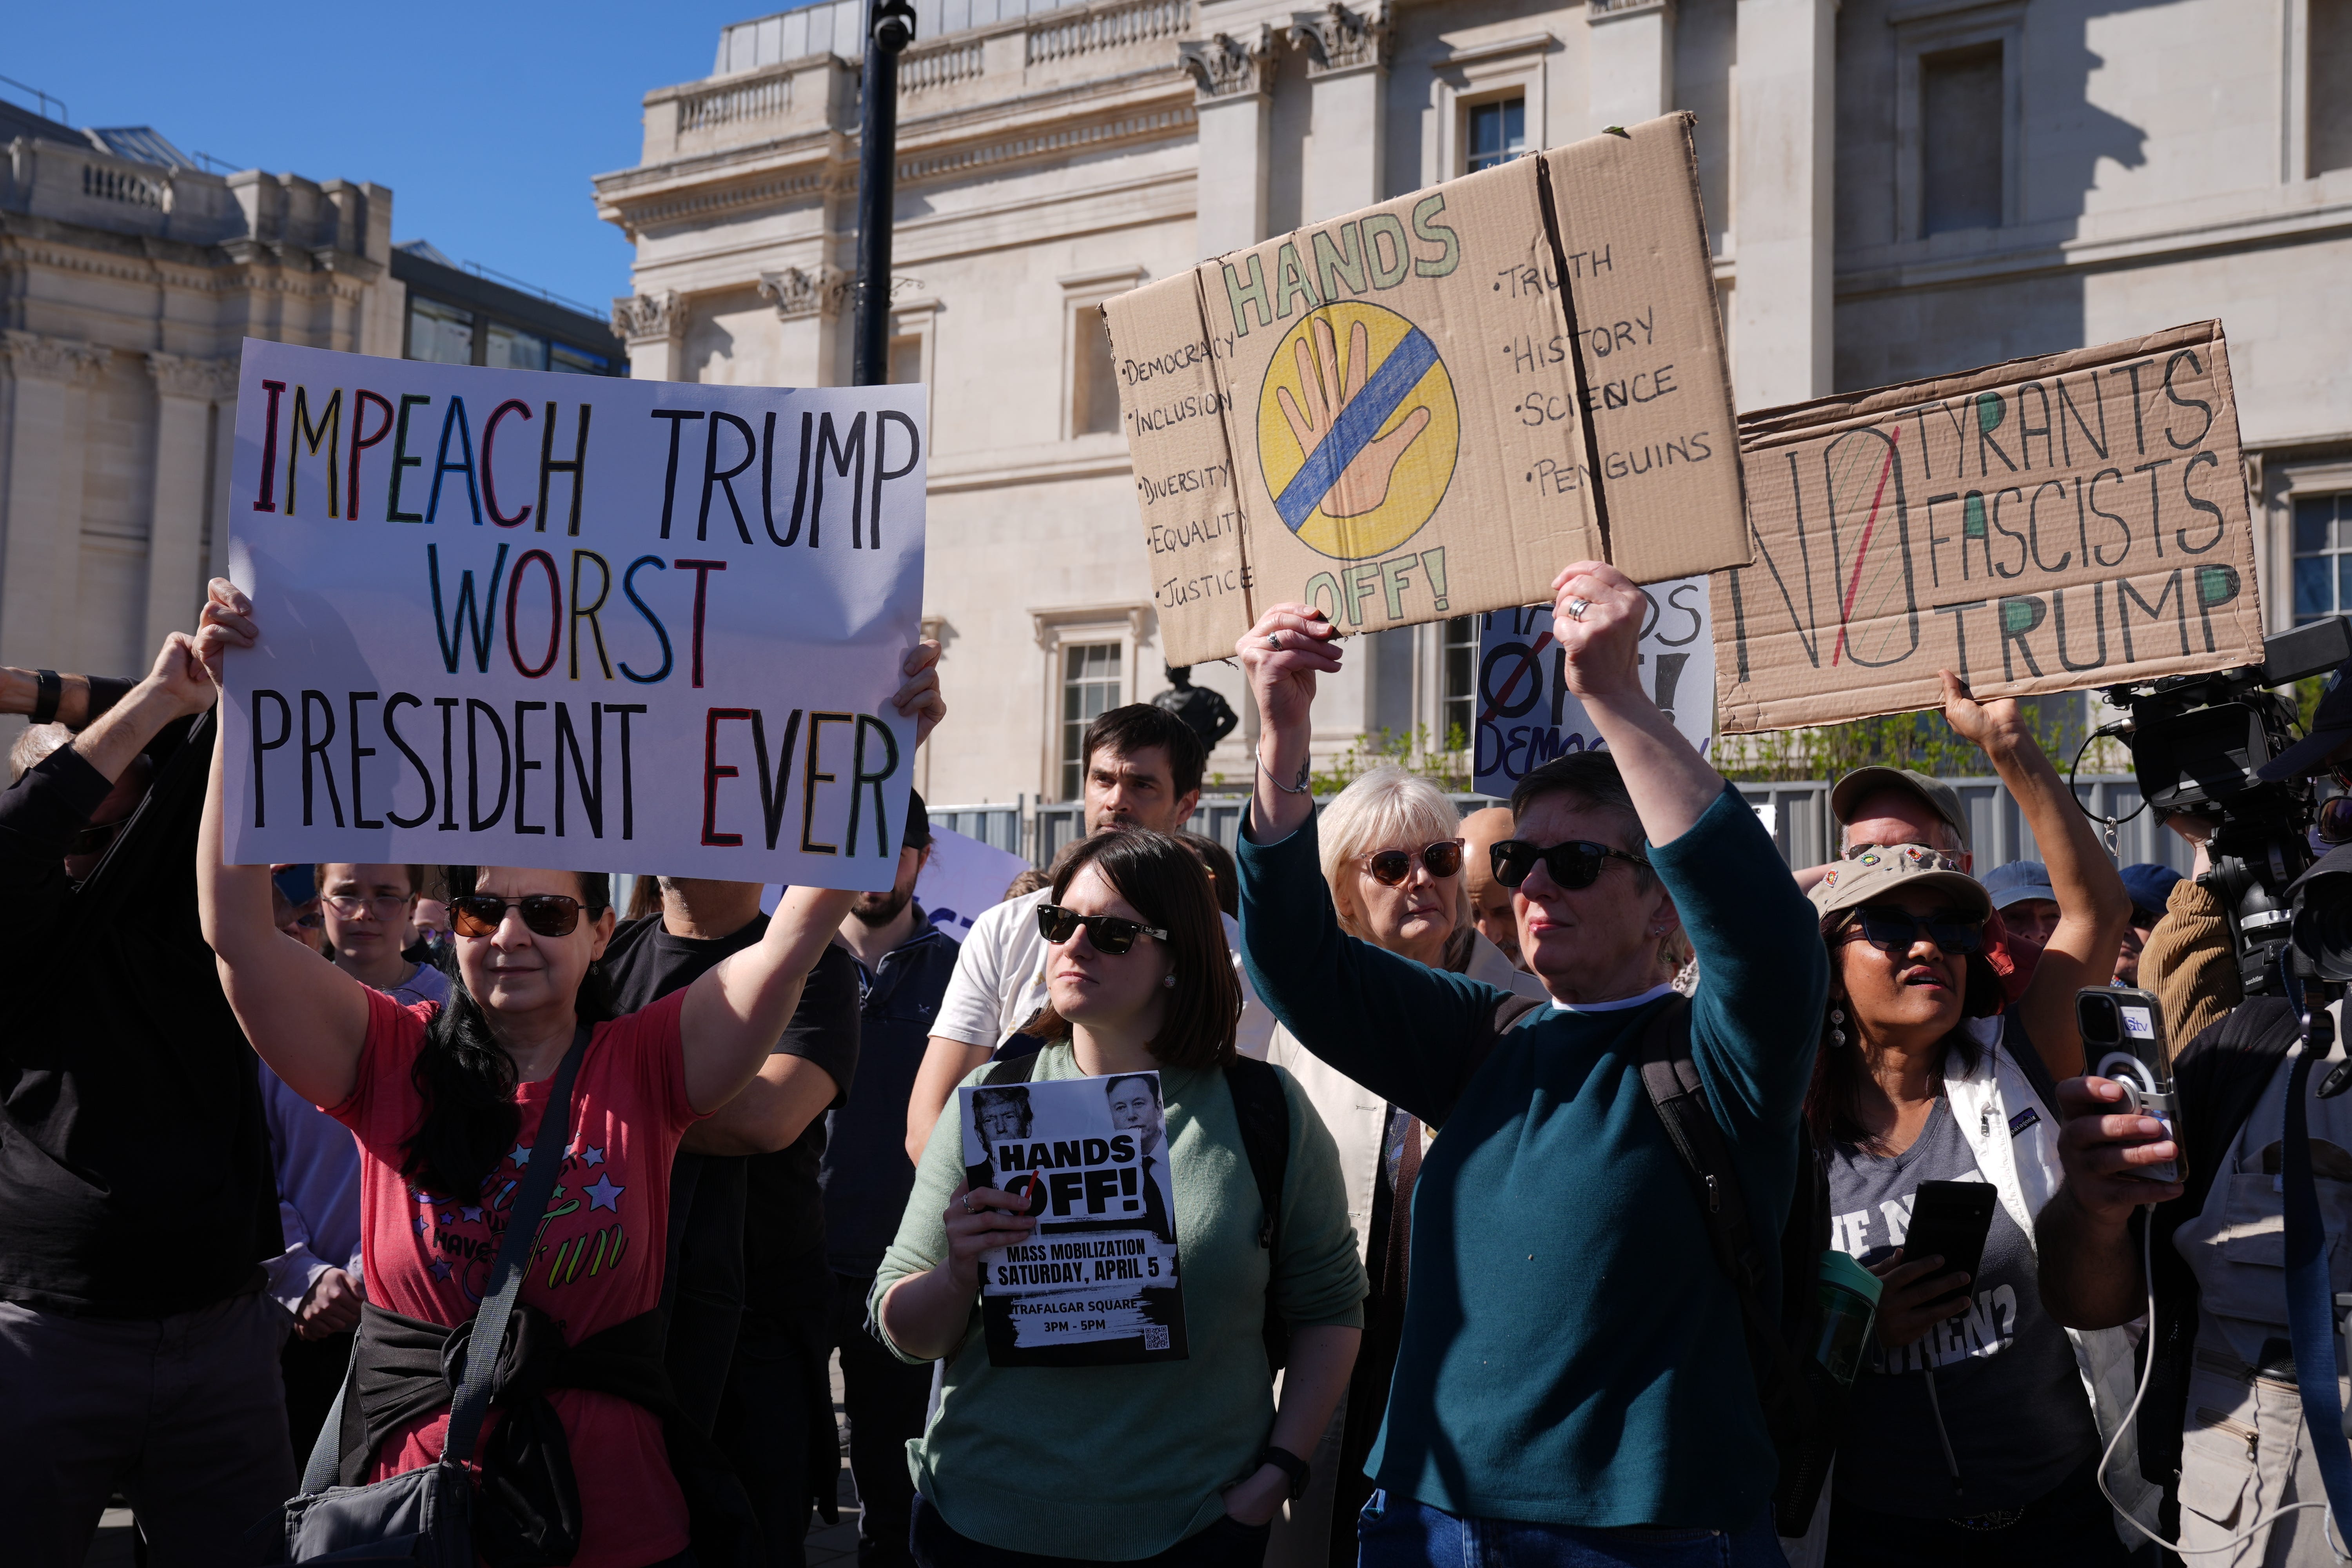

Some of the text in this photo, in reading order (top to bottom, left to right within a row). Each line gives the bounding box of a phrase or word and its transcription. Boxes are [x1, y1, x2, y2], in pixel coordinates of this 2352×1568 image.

[1222, 192, 1460, 338] HANDS
[1498, 244, 1612, 299] TRUTH
[1125, 331, 1233, 386] DEMOCRACY
[1514, 306, 1652, 374] HISTORY
[1136, 389, 1232, 437] INCLUSION
[1522, 365, 1677, 426] SCIENCE
[1895, 349, 2213, 480] TYRANTS
[253, 379, 920, 549] IMPEACH TRUMP
[1142, 459, 1229, 505] DIVERSITY
[1534, 432, 1711, 497] PENGUINS
[1151, 508, 1247, 554] EQUALITY
[1927, 450, 2225, 588] FASCISTS
[1163, 566, 1253, 608] JUSTICE
[1305, 546, 1449, 628] OFF!
[426, 543, 727, 688] WORST
[1933, 563, 2241, 689] TRUMP
[252, 689, 899, 858] PRESIDENT EVER
[2245, 975, 2263, 985] sachtler
[2010, 1116, 2036, 1135] patagonia
[999, 1135, 1135, 1172] HANDS
[1004, 1167, 1139, 1217] OFF!
[433, 1227, 490, 1263] HAVE
[997, 1256, 1159, 1285] SATURDAY, APRIL 5
[1006, 1238, 1145, 1262] MASS MOBILIZATION
[1013, 1299, 1138, 1315] TRAFALGAR SQUARE
[1044, 1321, 1069, 1332] 3PM
[1080, 1319, 1105, 1330] 5PM
